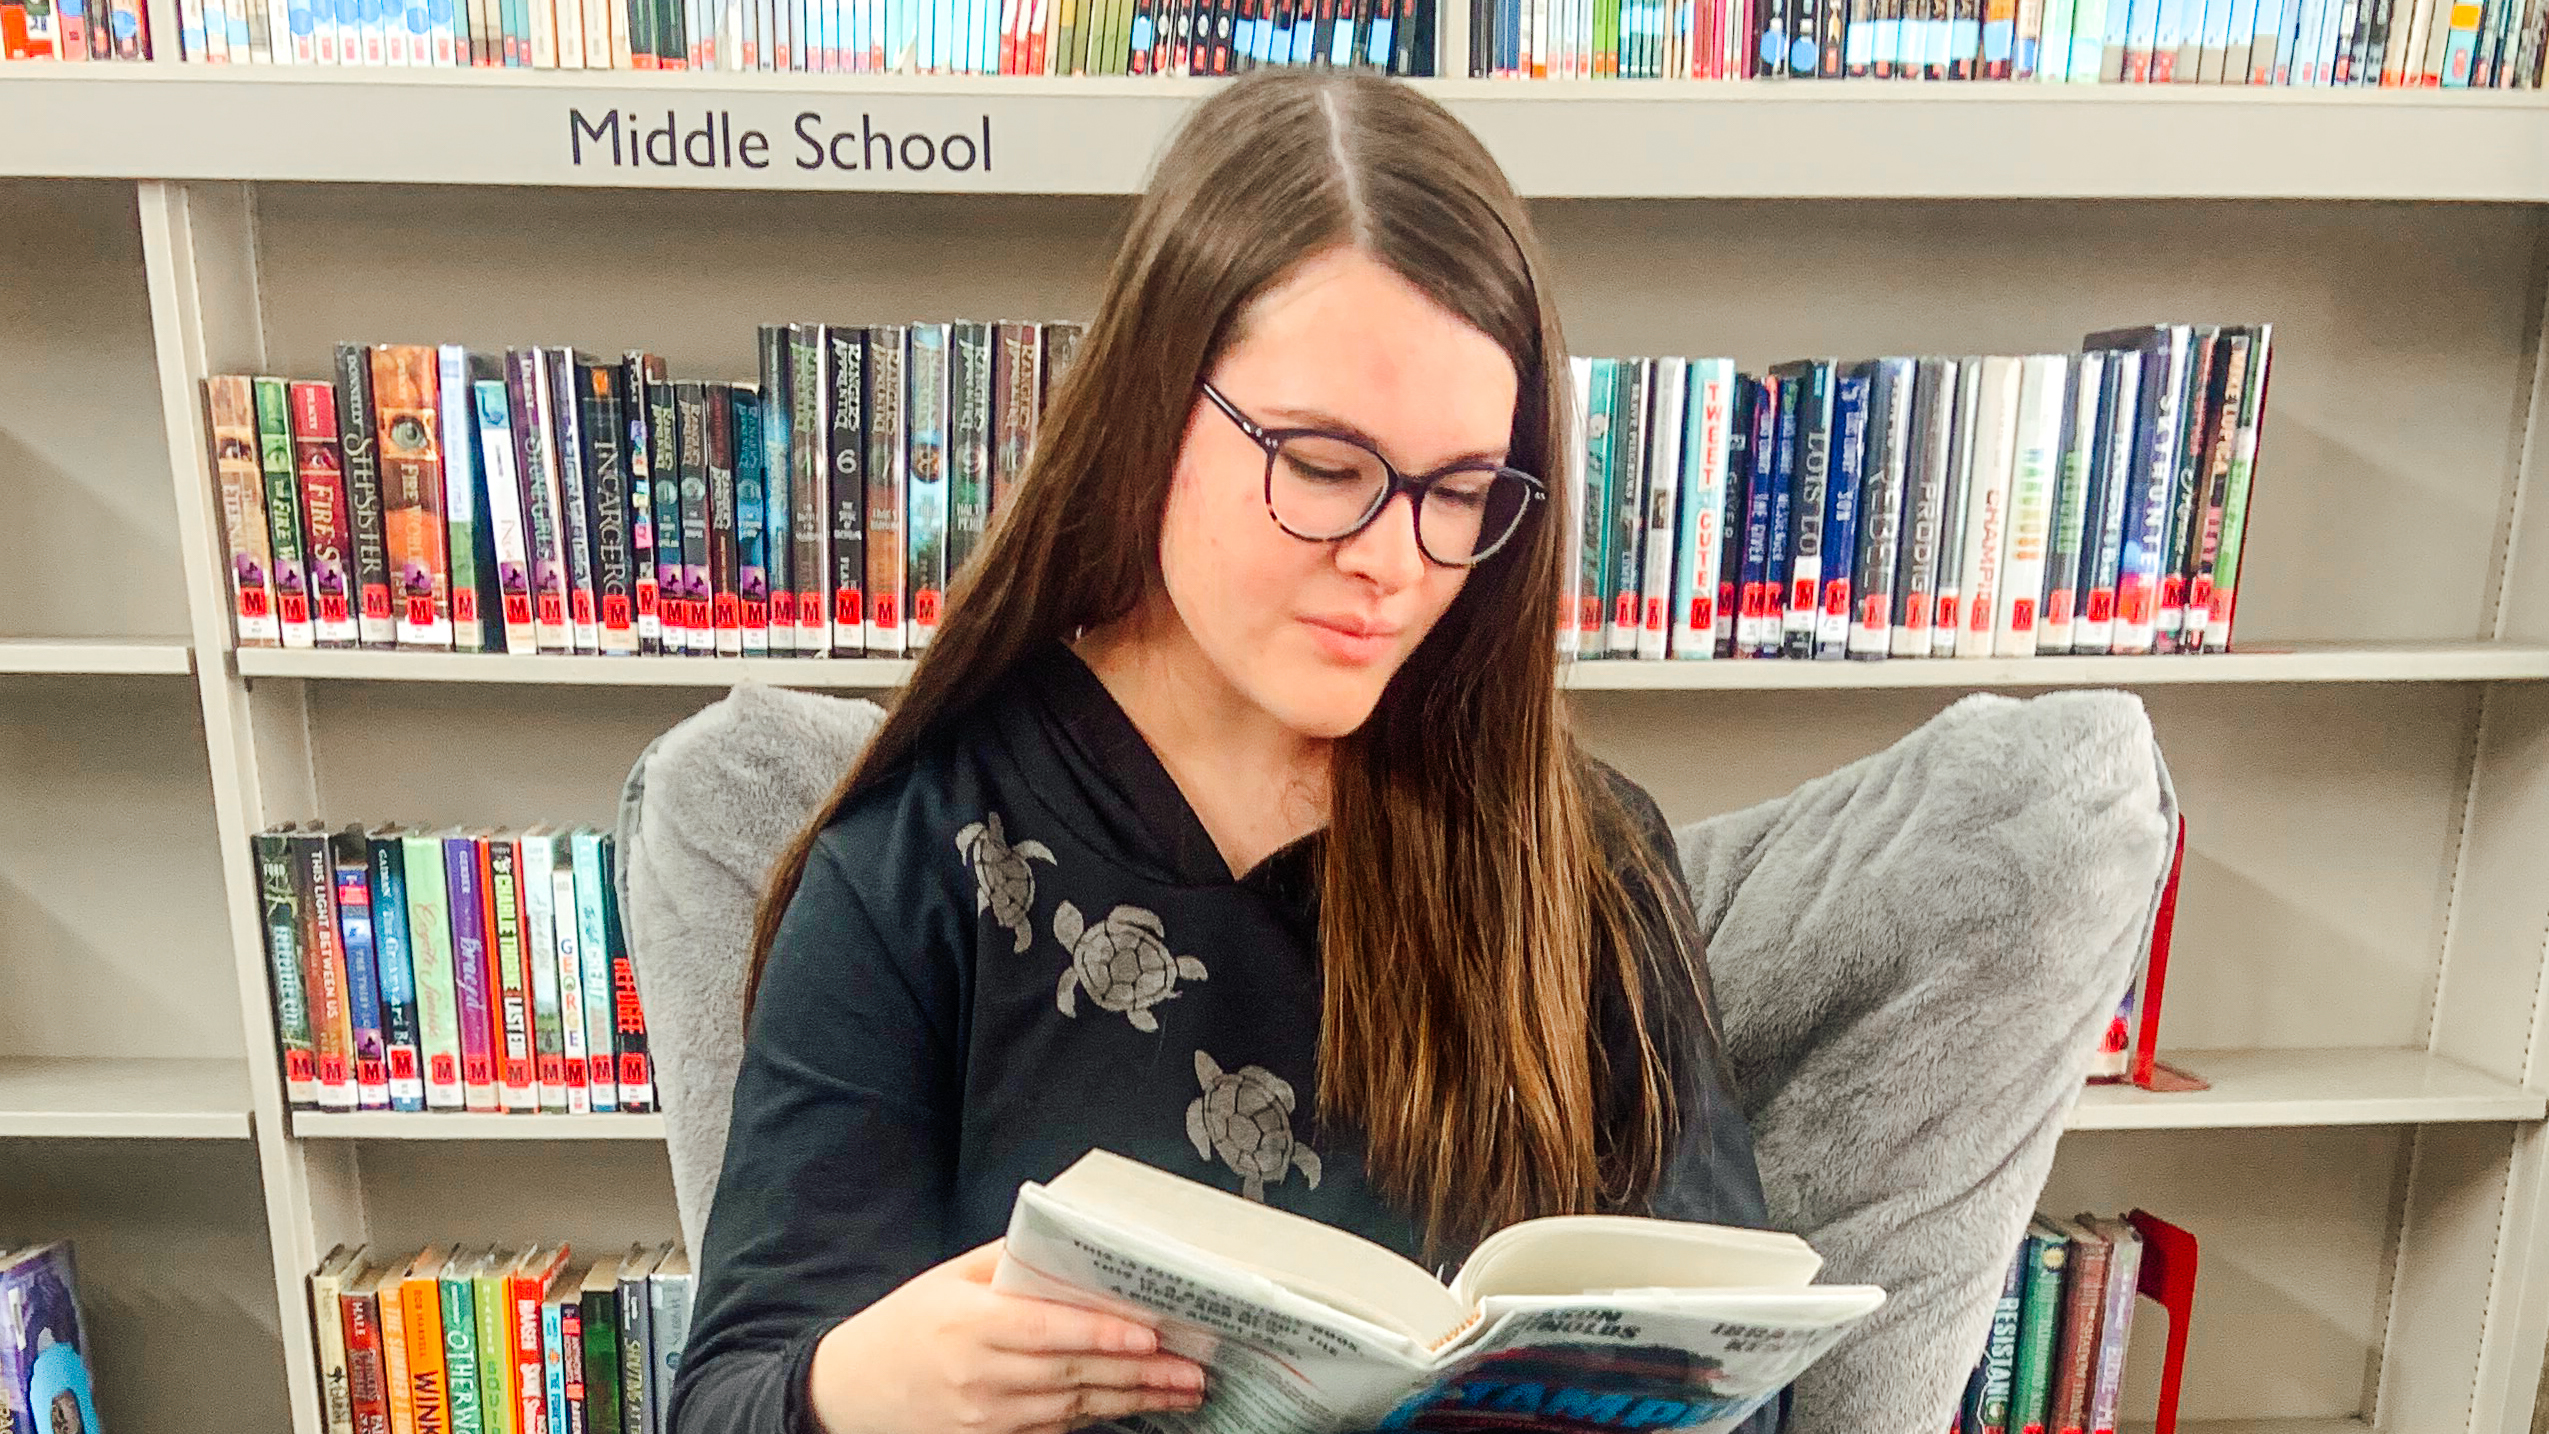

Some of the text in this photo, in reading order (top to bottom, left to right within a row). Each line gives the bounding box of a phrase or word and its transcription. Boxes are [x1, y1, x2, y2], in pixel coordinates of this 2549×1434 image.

[569, 108, 991, 172] Middle School
[346, 353, 365, 432] DONNELLY
[2215, 349, 2245, 475] MIKE LUPICA
[836, 449, 857, 474] 6
[400, 463, 420, 504] FIRE
[1697, 383, 1721, 587] TWEET CUTE
[2140, 395, 2171, 566] SKYHUNTE
[343, 433, 382, 575] STEPSISTER
[1799, 432, 1826, 556] LOIS LO
[274, 498, 292, 540] FIRE
[308, 482, 335, 537] FIRE
[1912, 482, 1937, 591] PRODIG
[1977, 489, 2000, 599] CHAMPI
[244, 593, 262, 611] M
[284, 599, 303, 617] M
[323, 598, 342, 616] M
[410, 599, 428, 619] M
[458, 597, 474, 615] M
[510, 601, 528, 619] M
[666, 603, 682, 621] M
[717, 604, 733, 620] M
[774, 600, 790, 618] M
[804, 603, 819, 621] M
[838, 599, 855, 617] M
[878, 603, 892, 621] M
[610, 610, 626, 624] M
[691, 605, 706, 622] M
[748, 604, 763, 621] M
[1693, 605, 1710, 622] M
[2021, 608, 2032, 624] M
[312, 851, 323, 881] THIS
[378, 849, 391, 898] GAIMAN
[314, 882, 328, 926] LIGHT
[494, 874, 517, 937] CHARLIE
[319, 928, 336, 997] BETWEEN
[499, 936, 522, 991] THORNE
[560, 938, 580, 1047] GEORGE
[324, 998, 338, 1018] US
[504, 997, 524, 1034] LAST
[293, 1059, 309, 1074] M
[326, 1062, 341, 1078] M
[364, 1062, 379, 1077] M
[394, 1056, 410, 1072] M
[437, 1062, 450, 1077] M
[471, 1062, 486, 1078] M
[509, 1066, 523, 1082] M
[568, 1066, 583, 1081] M
[595, 1062, 610, 1078] M
[627, 1062, 642, 1078] M
[352, 1302, 366, 1336] HALE
[483, 1285, 494, 1354] HIAASEN
[386, 1337, 409, 1398] SUMMER
[447, 1330, 478, 1434] OTHERWO
[414, 1370, 442, 1434] WINK
[487, 1361, 500, 1434] SQUI
